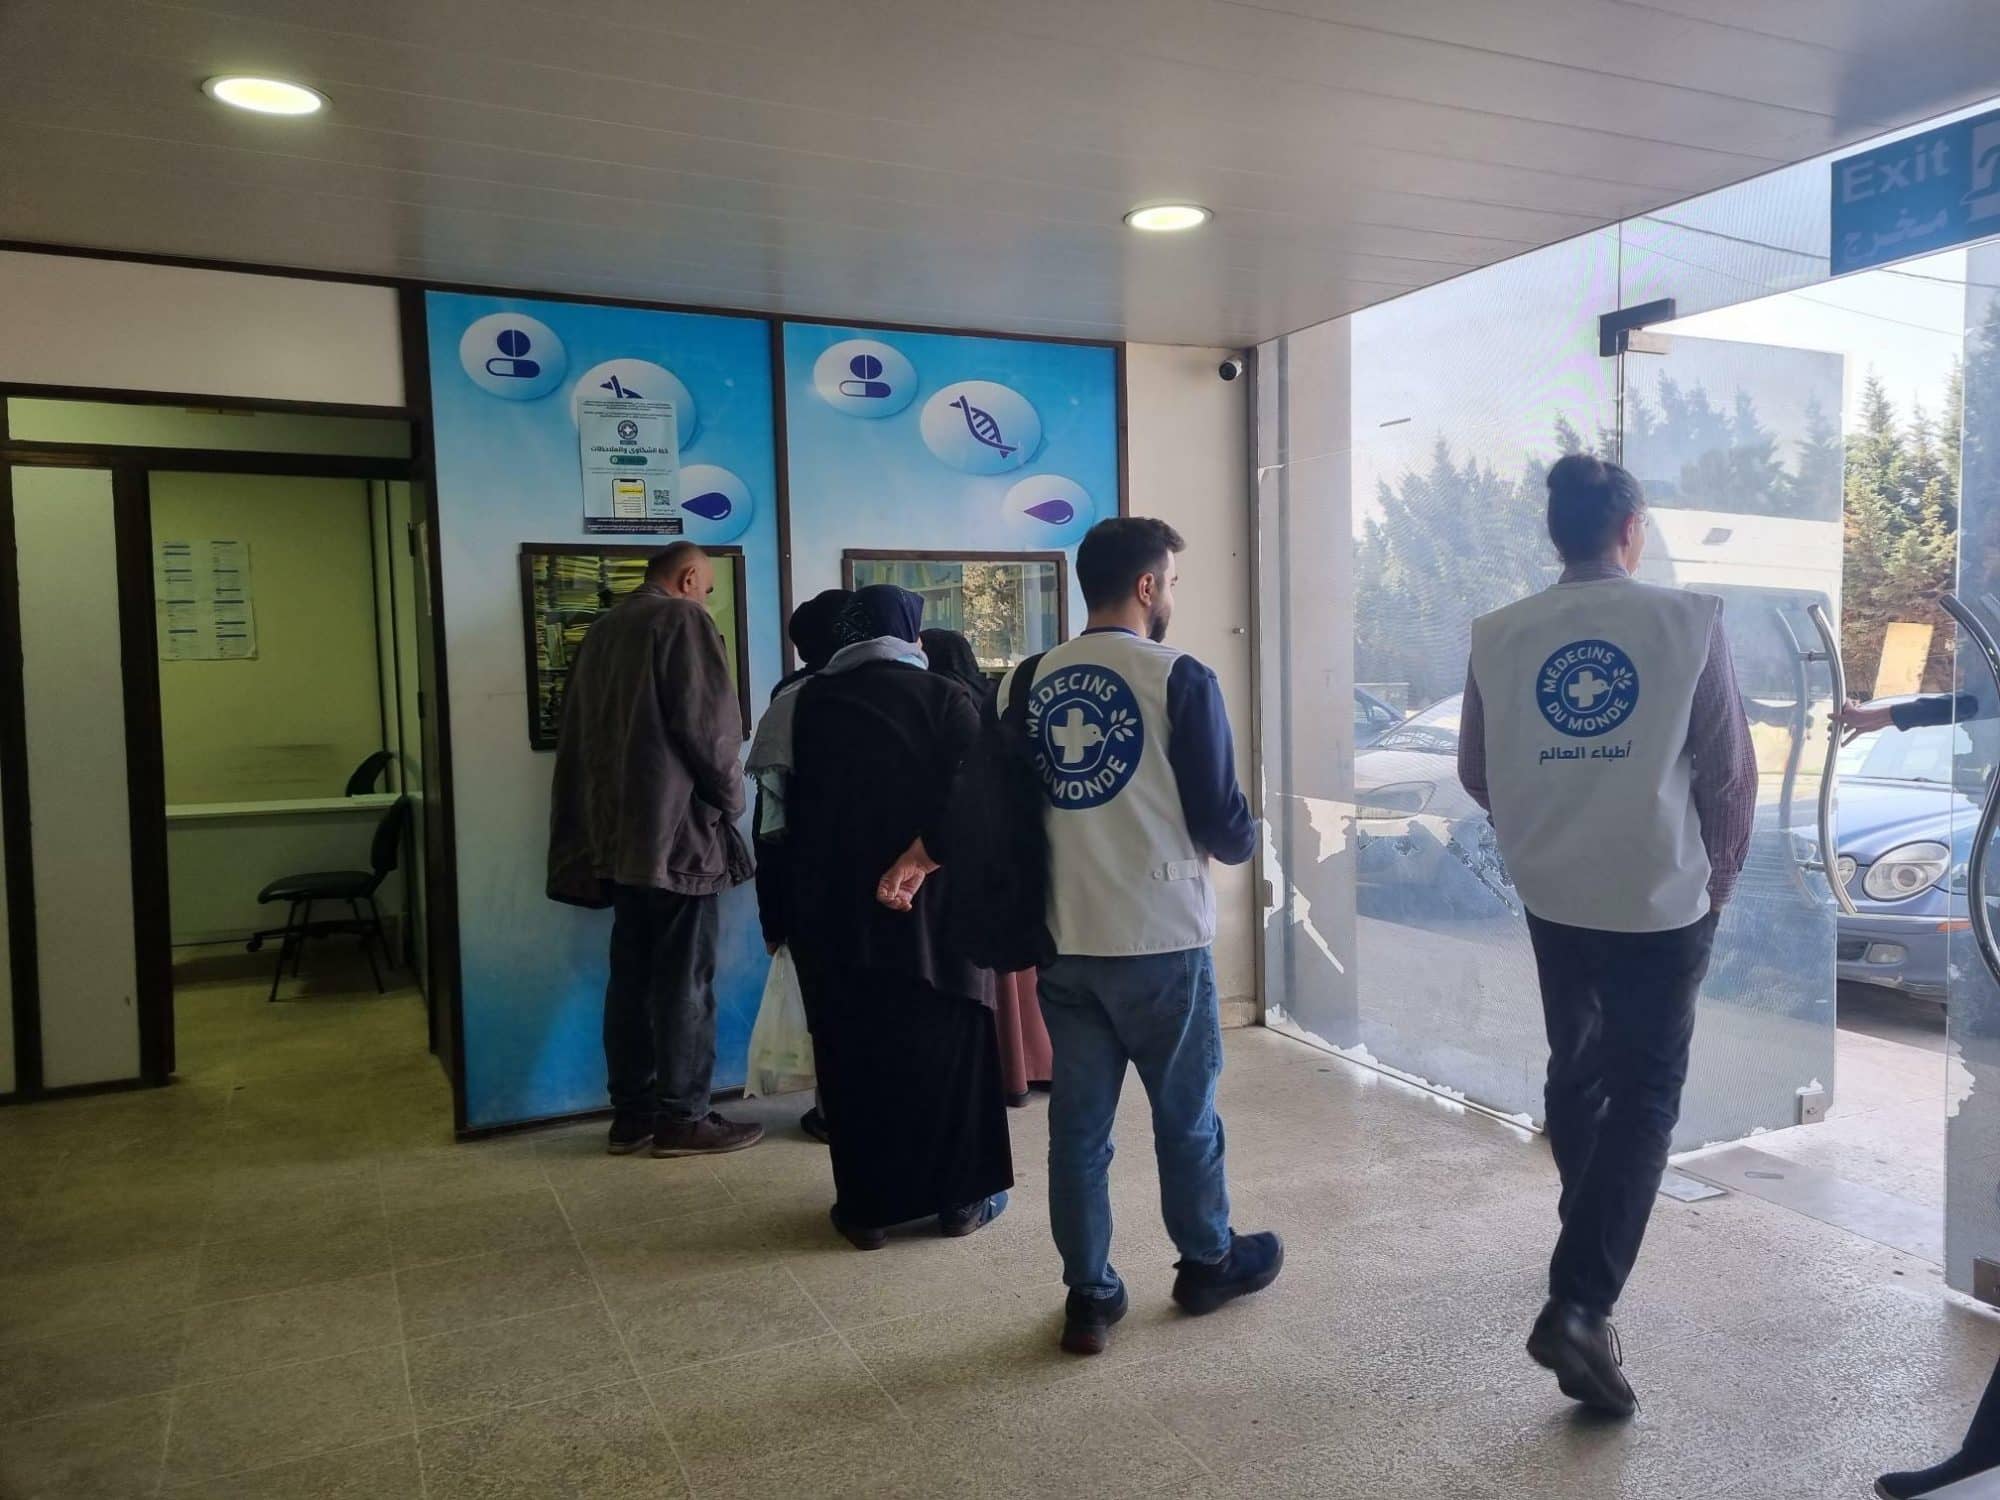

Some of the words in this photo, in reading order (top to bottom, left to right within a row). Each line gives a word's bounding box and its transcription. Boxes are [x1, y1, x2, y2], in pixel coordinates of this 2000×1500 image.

[1843, 139, 1951, 203] Exit
[1843, 208, 1948, 265] مخرج
[1543, 646, 1616, 694] MÉDECINS
[1024, 672, 1119, 738] MÉDECINS
[1546, 701, 1567, 723] DU
[1567, 697, 1629, 732] MONDE
[1539, 745, 1586, 766] العالم
[1590, 740, 1633, 763] أطباء
[1052, 755, 1128, 801] MONDE
